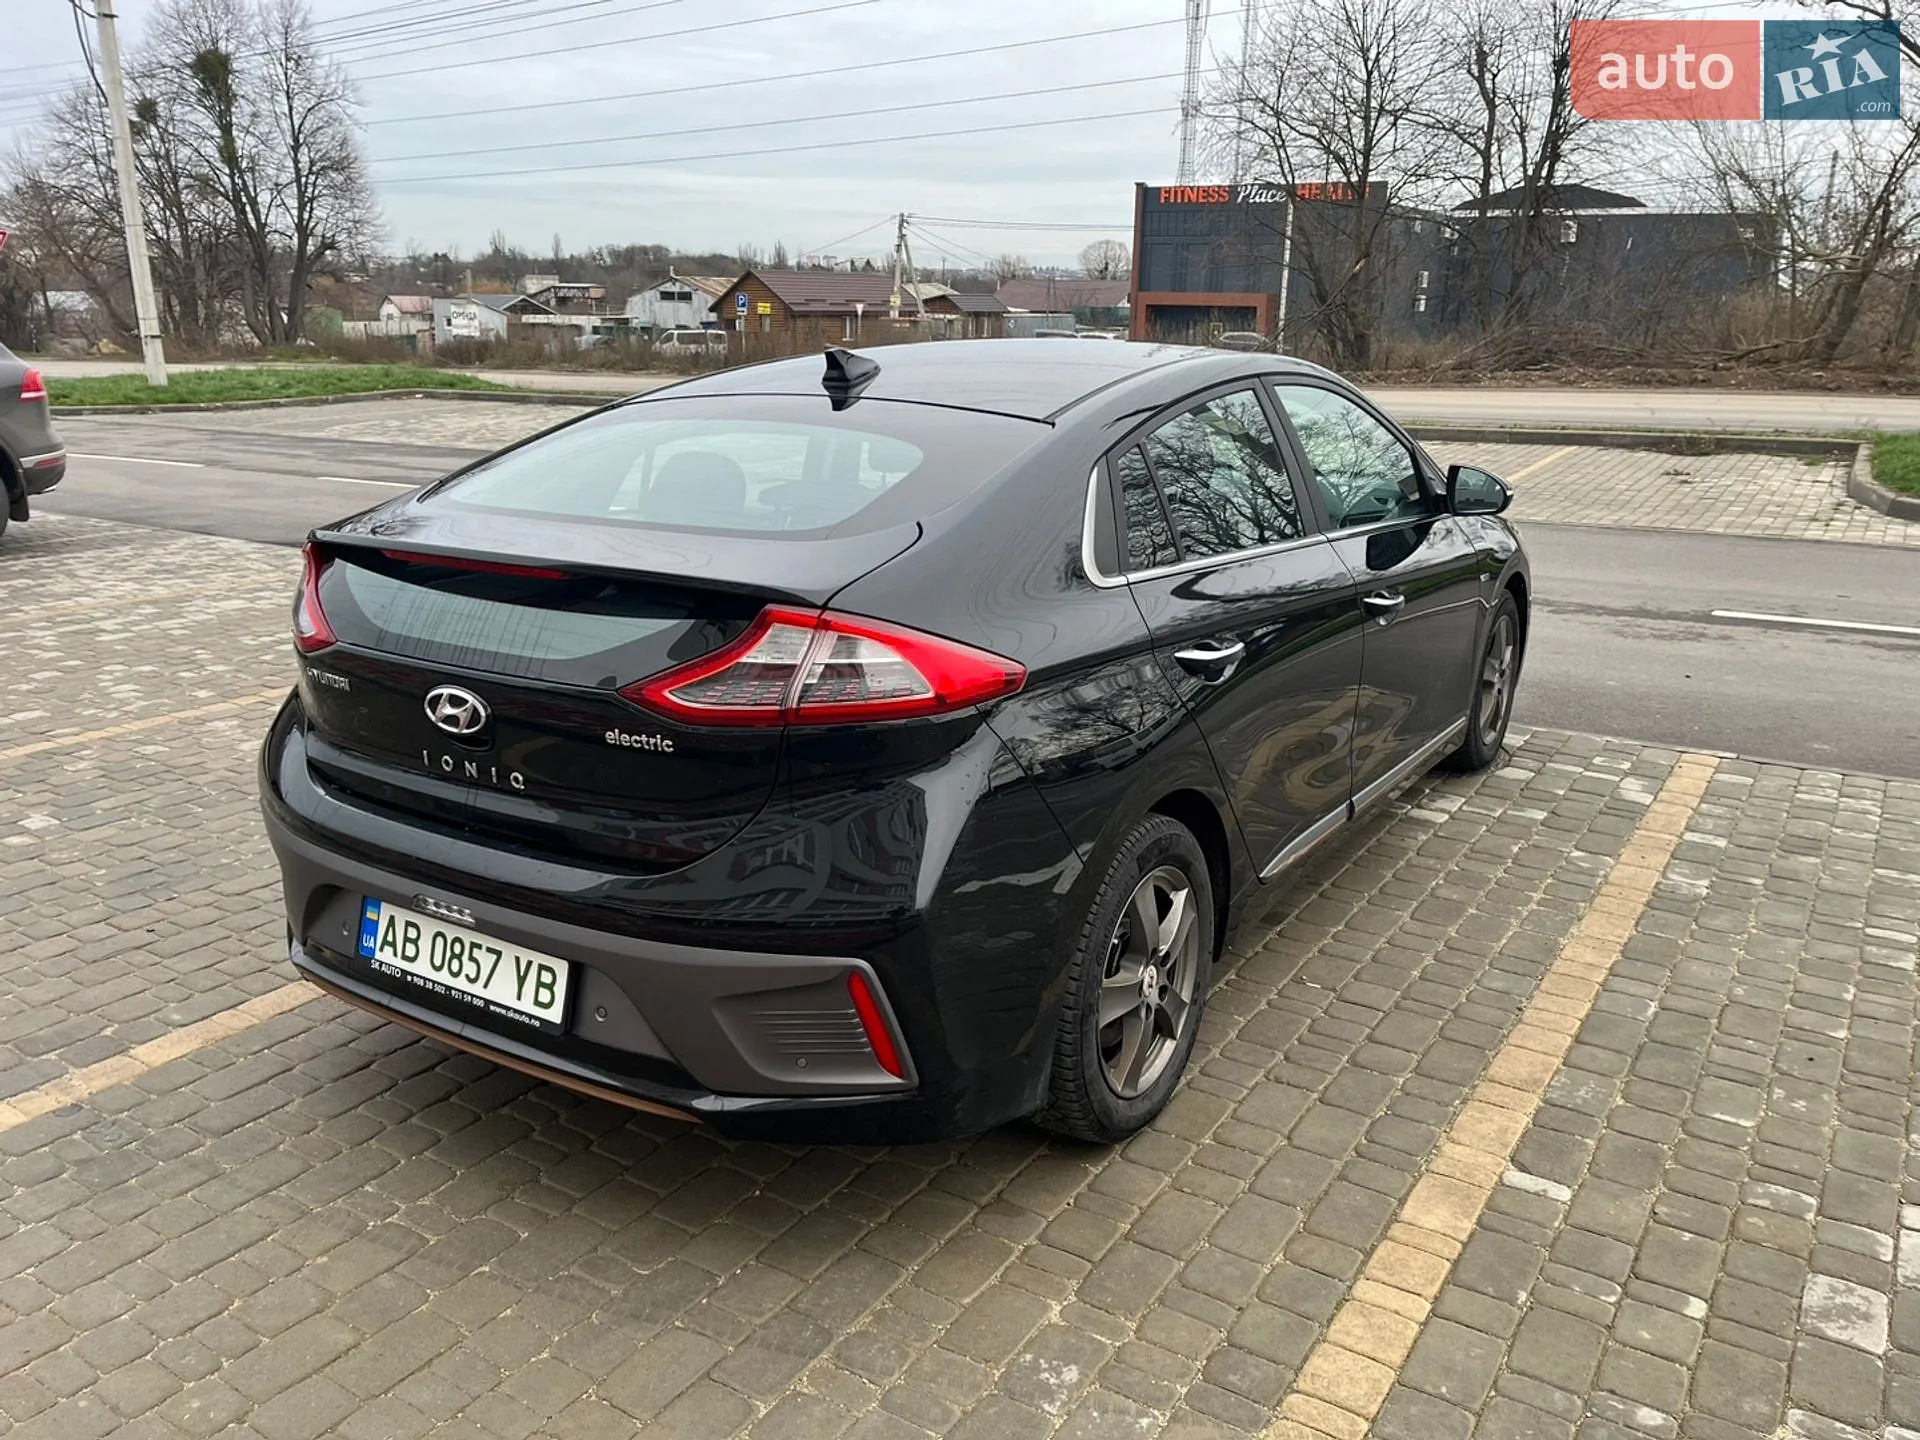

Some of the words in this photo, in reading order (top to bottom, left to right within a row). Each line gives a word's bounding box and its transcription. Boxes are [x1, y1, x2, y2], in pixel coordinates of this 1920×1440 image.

[1160, 185, 1229, 204] FITNESS
[1236, 183, 1287, 203] Place
[1296, 182, 1371, 201] HEAL
[738, 295, 745, 307] P
[605, 729, 674, 753] electric
[422, 750, 526, 789] IONIQ
[362, 933, 375, 949] UA
[370, 959, 380, 970] SK
[381, 963, 402, 978] AUTO
[379, 914, 422, 963] AB
[429, 930, 503, 990] 0857
[514, 954, 558, 1010] YB
